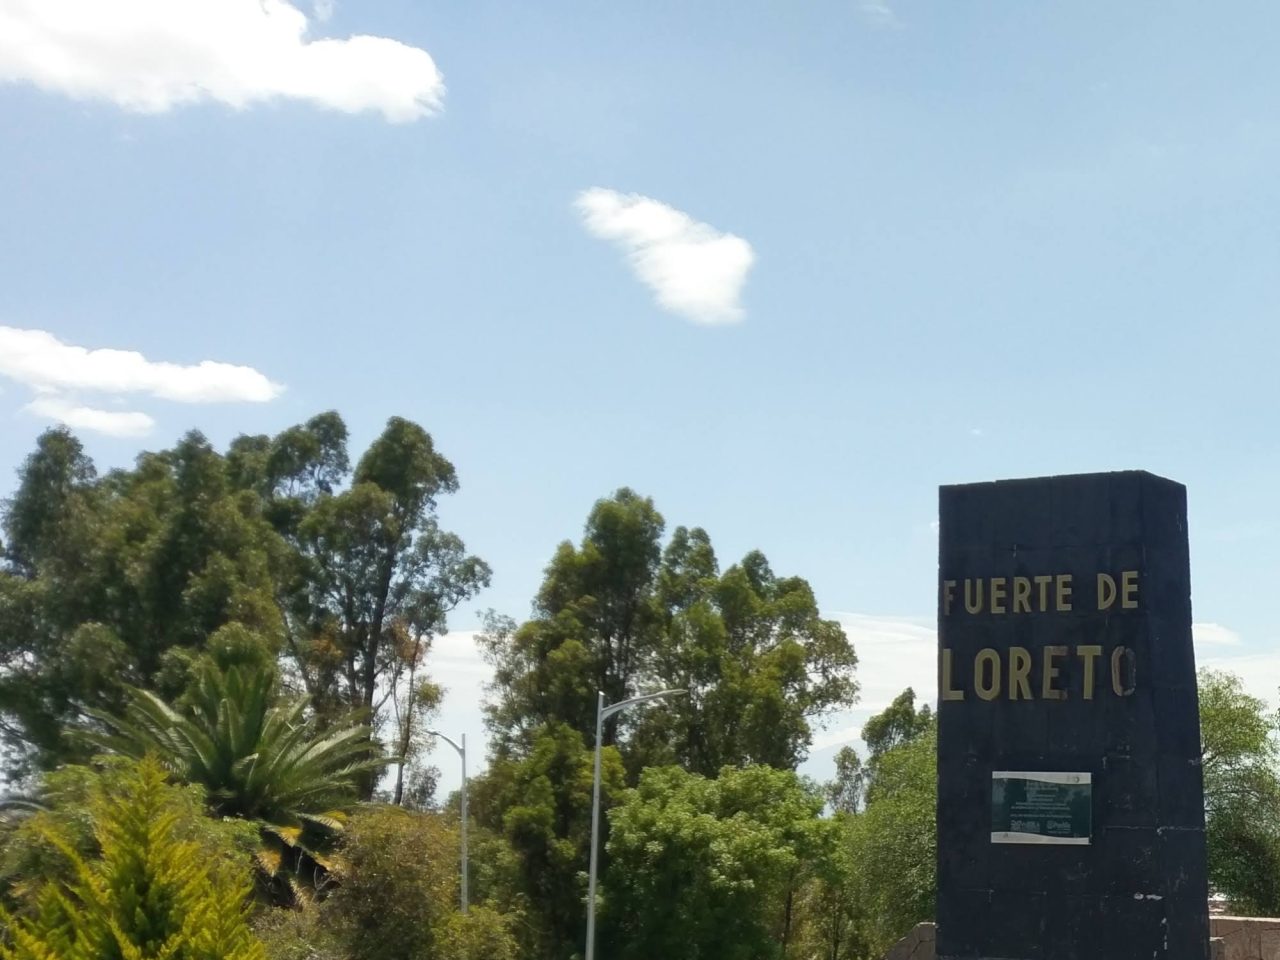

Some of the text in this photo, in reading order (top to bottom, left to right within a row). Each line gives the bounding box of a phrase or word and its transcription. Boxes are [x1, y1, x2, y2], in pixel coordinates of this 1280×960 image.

[943, 570, 1139, 616] FUERTE DE
[942, 644, 1137, 701] LORETO
